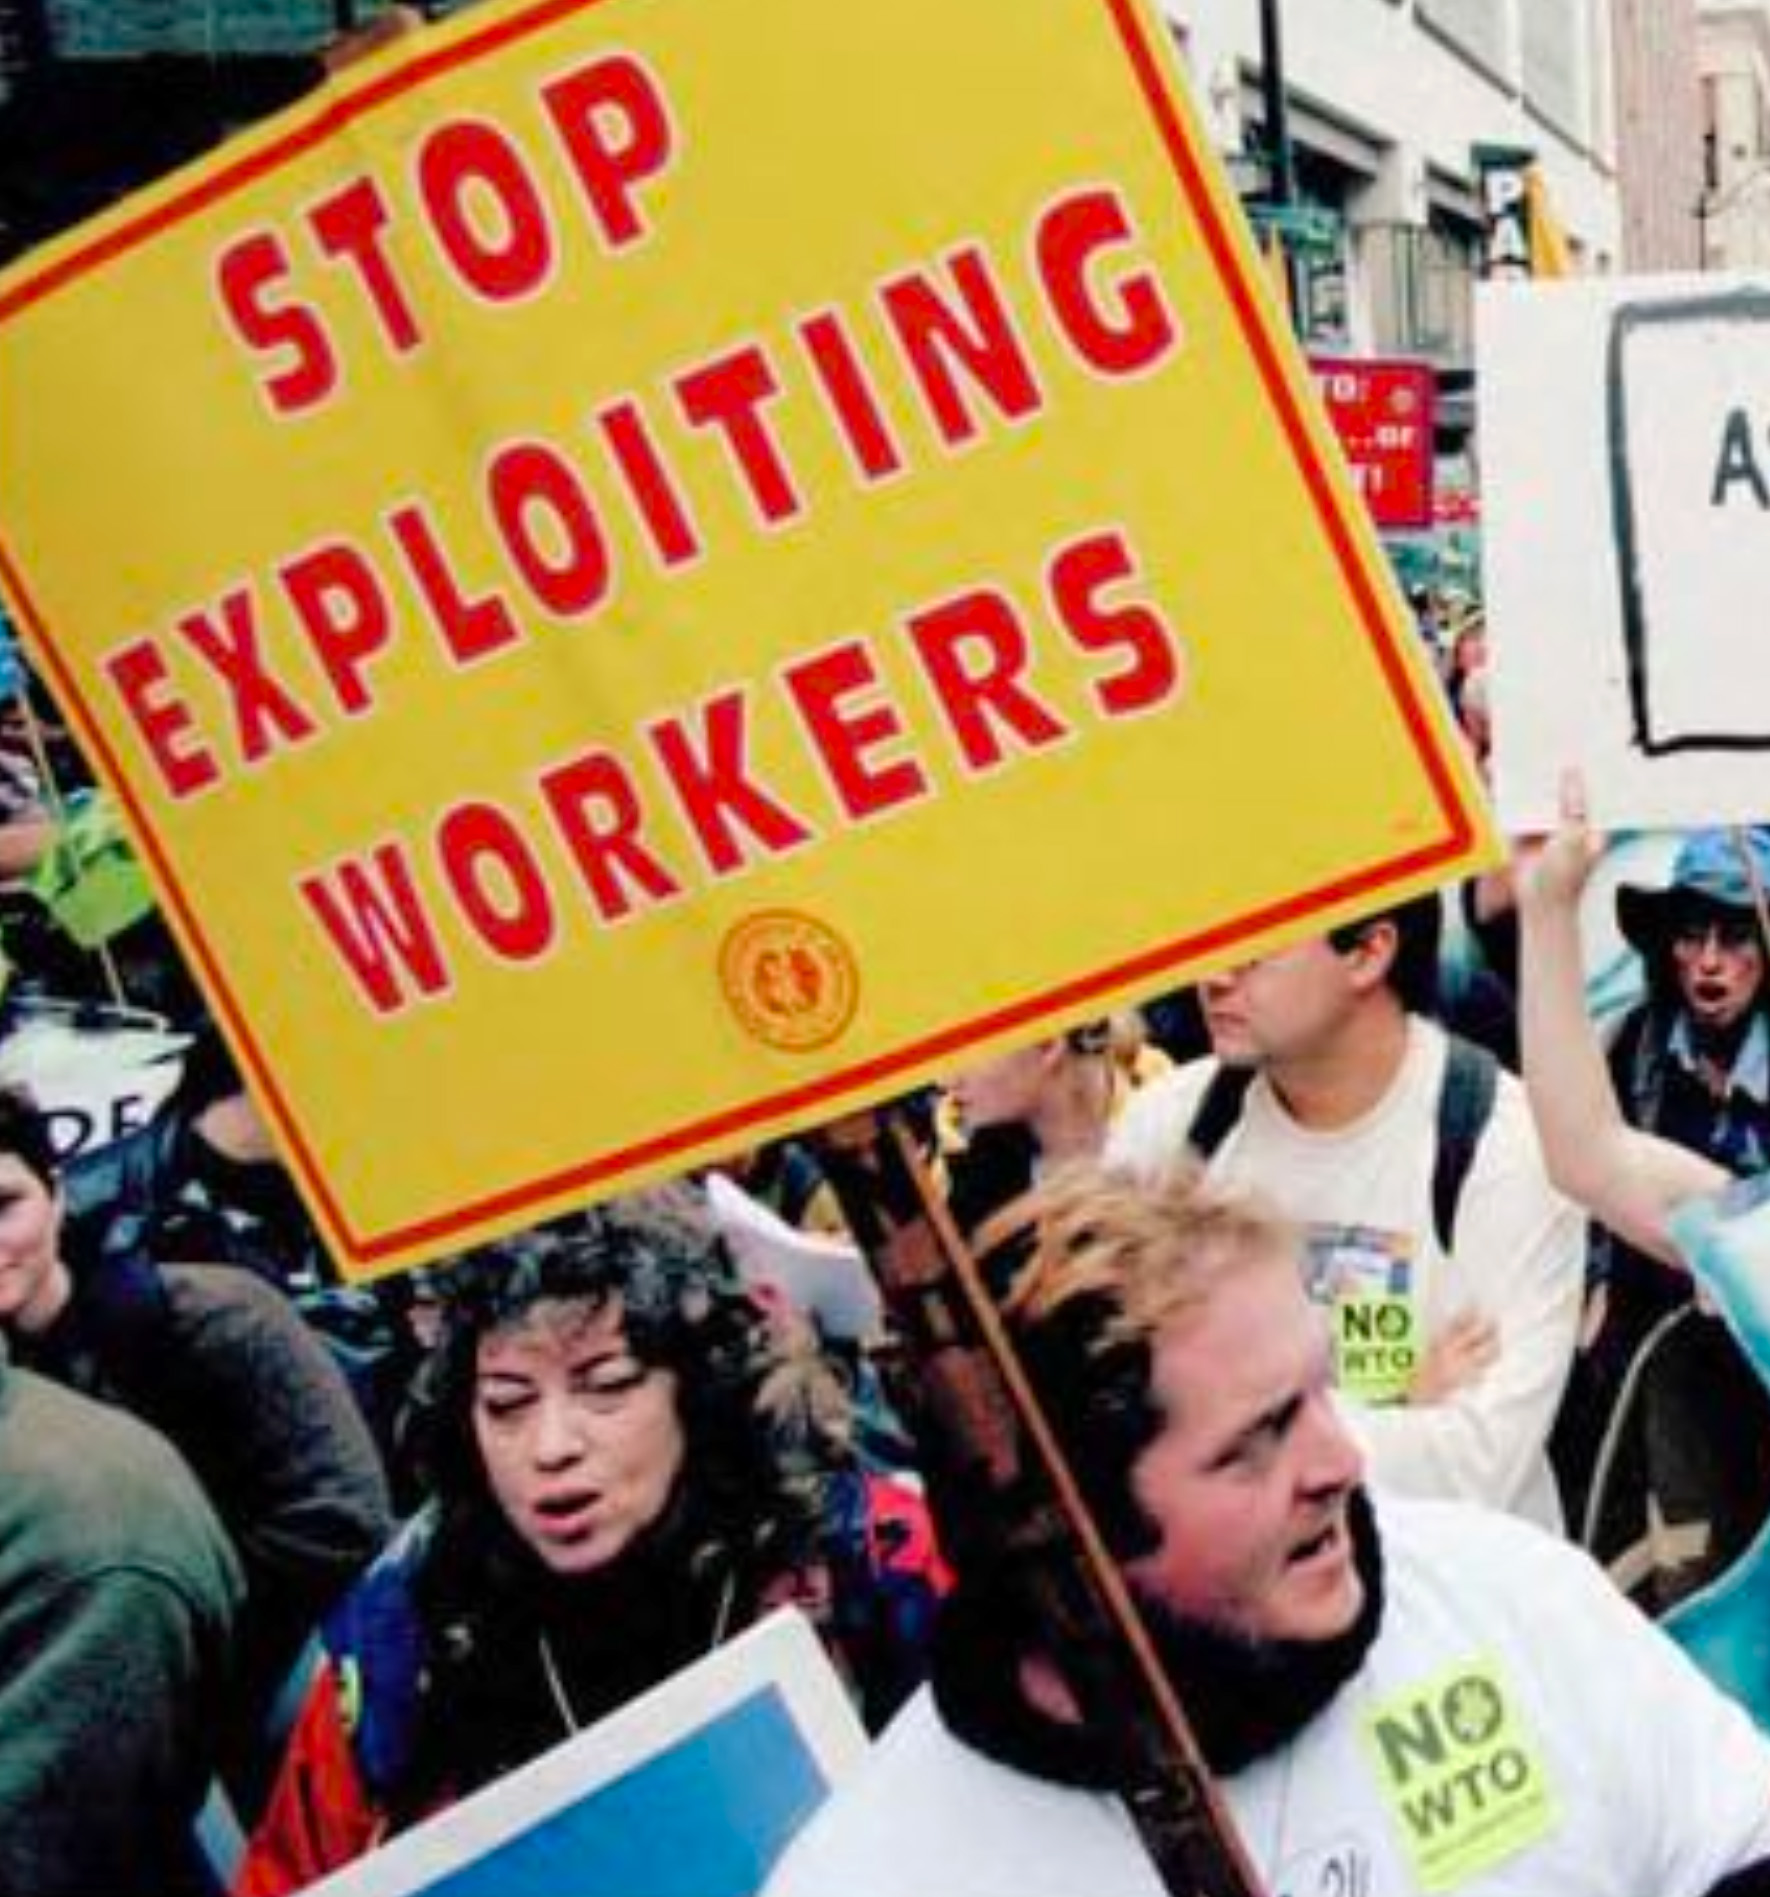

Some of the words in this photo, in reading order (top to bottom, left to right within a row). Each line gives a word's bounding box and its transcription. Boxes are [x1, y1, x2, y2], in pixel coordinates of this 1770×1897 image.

[216, 56, 671, 414] STOP
[108, 190, 1174, 798] EXPLOITING
[301, 534, 1179, 1014] WORKERS
[1342, 1303, 1411, 1342] NO
[1343, 1346, 1414, 1371] WTO
[1374, 1676, 1504, 1786] NO
[1401, 1748, 1529, 1838] WTO
